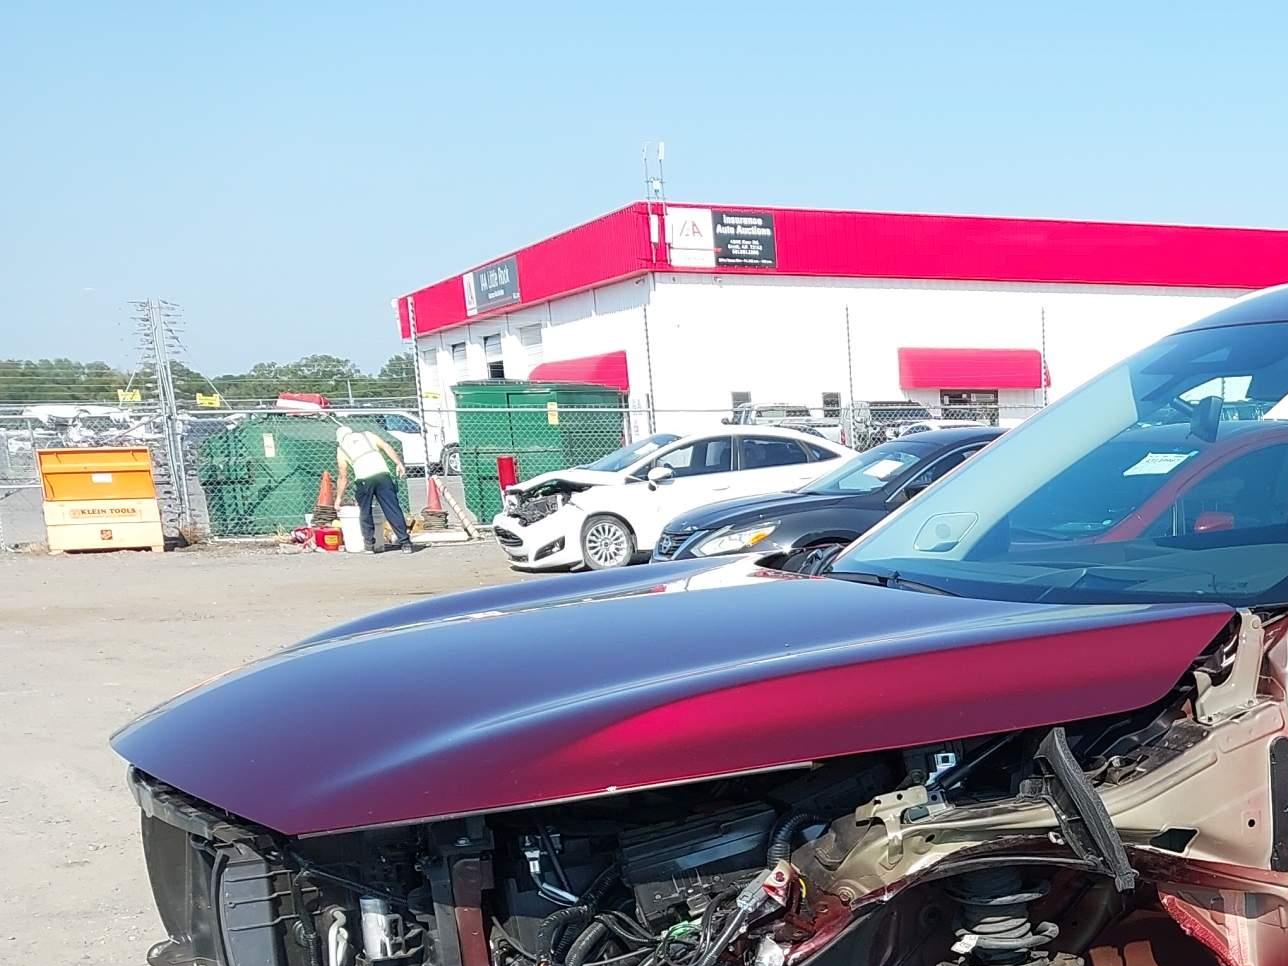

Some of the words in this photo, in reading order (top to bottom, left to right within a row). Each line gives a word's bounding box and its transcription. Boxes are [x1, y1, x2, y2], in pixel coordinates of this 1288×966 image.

[722, 214, 763, 226] Insurance
[716, 224, 735, 235] Auto
[736, 225, 772, 237] Auctions
